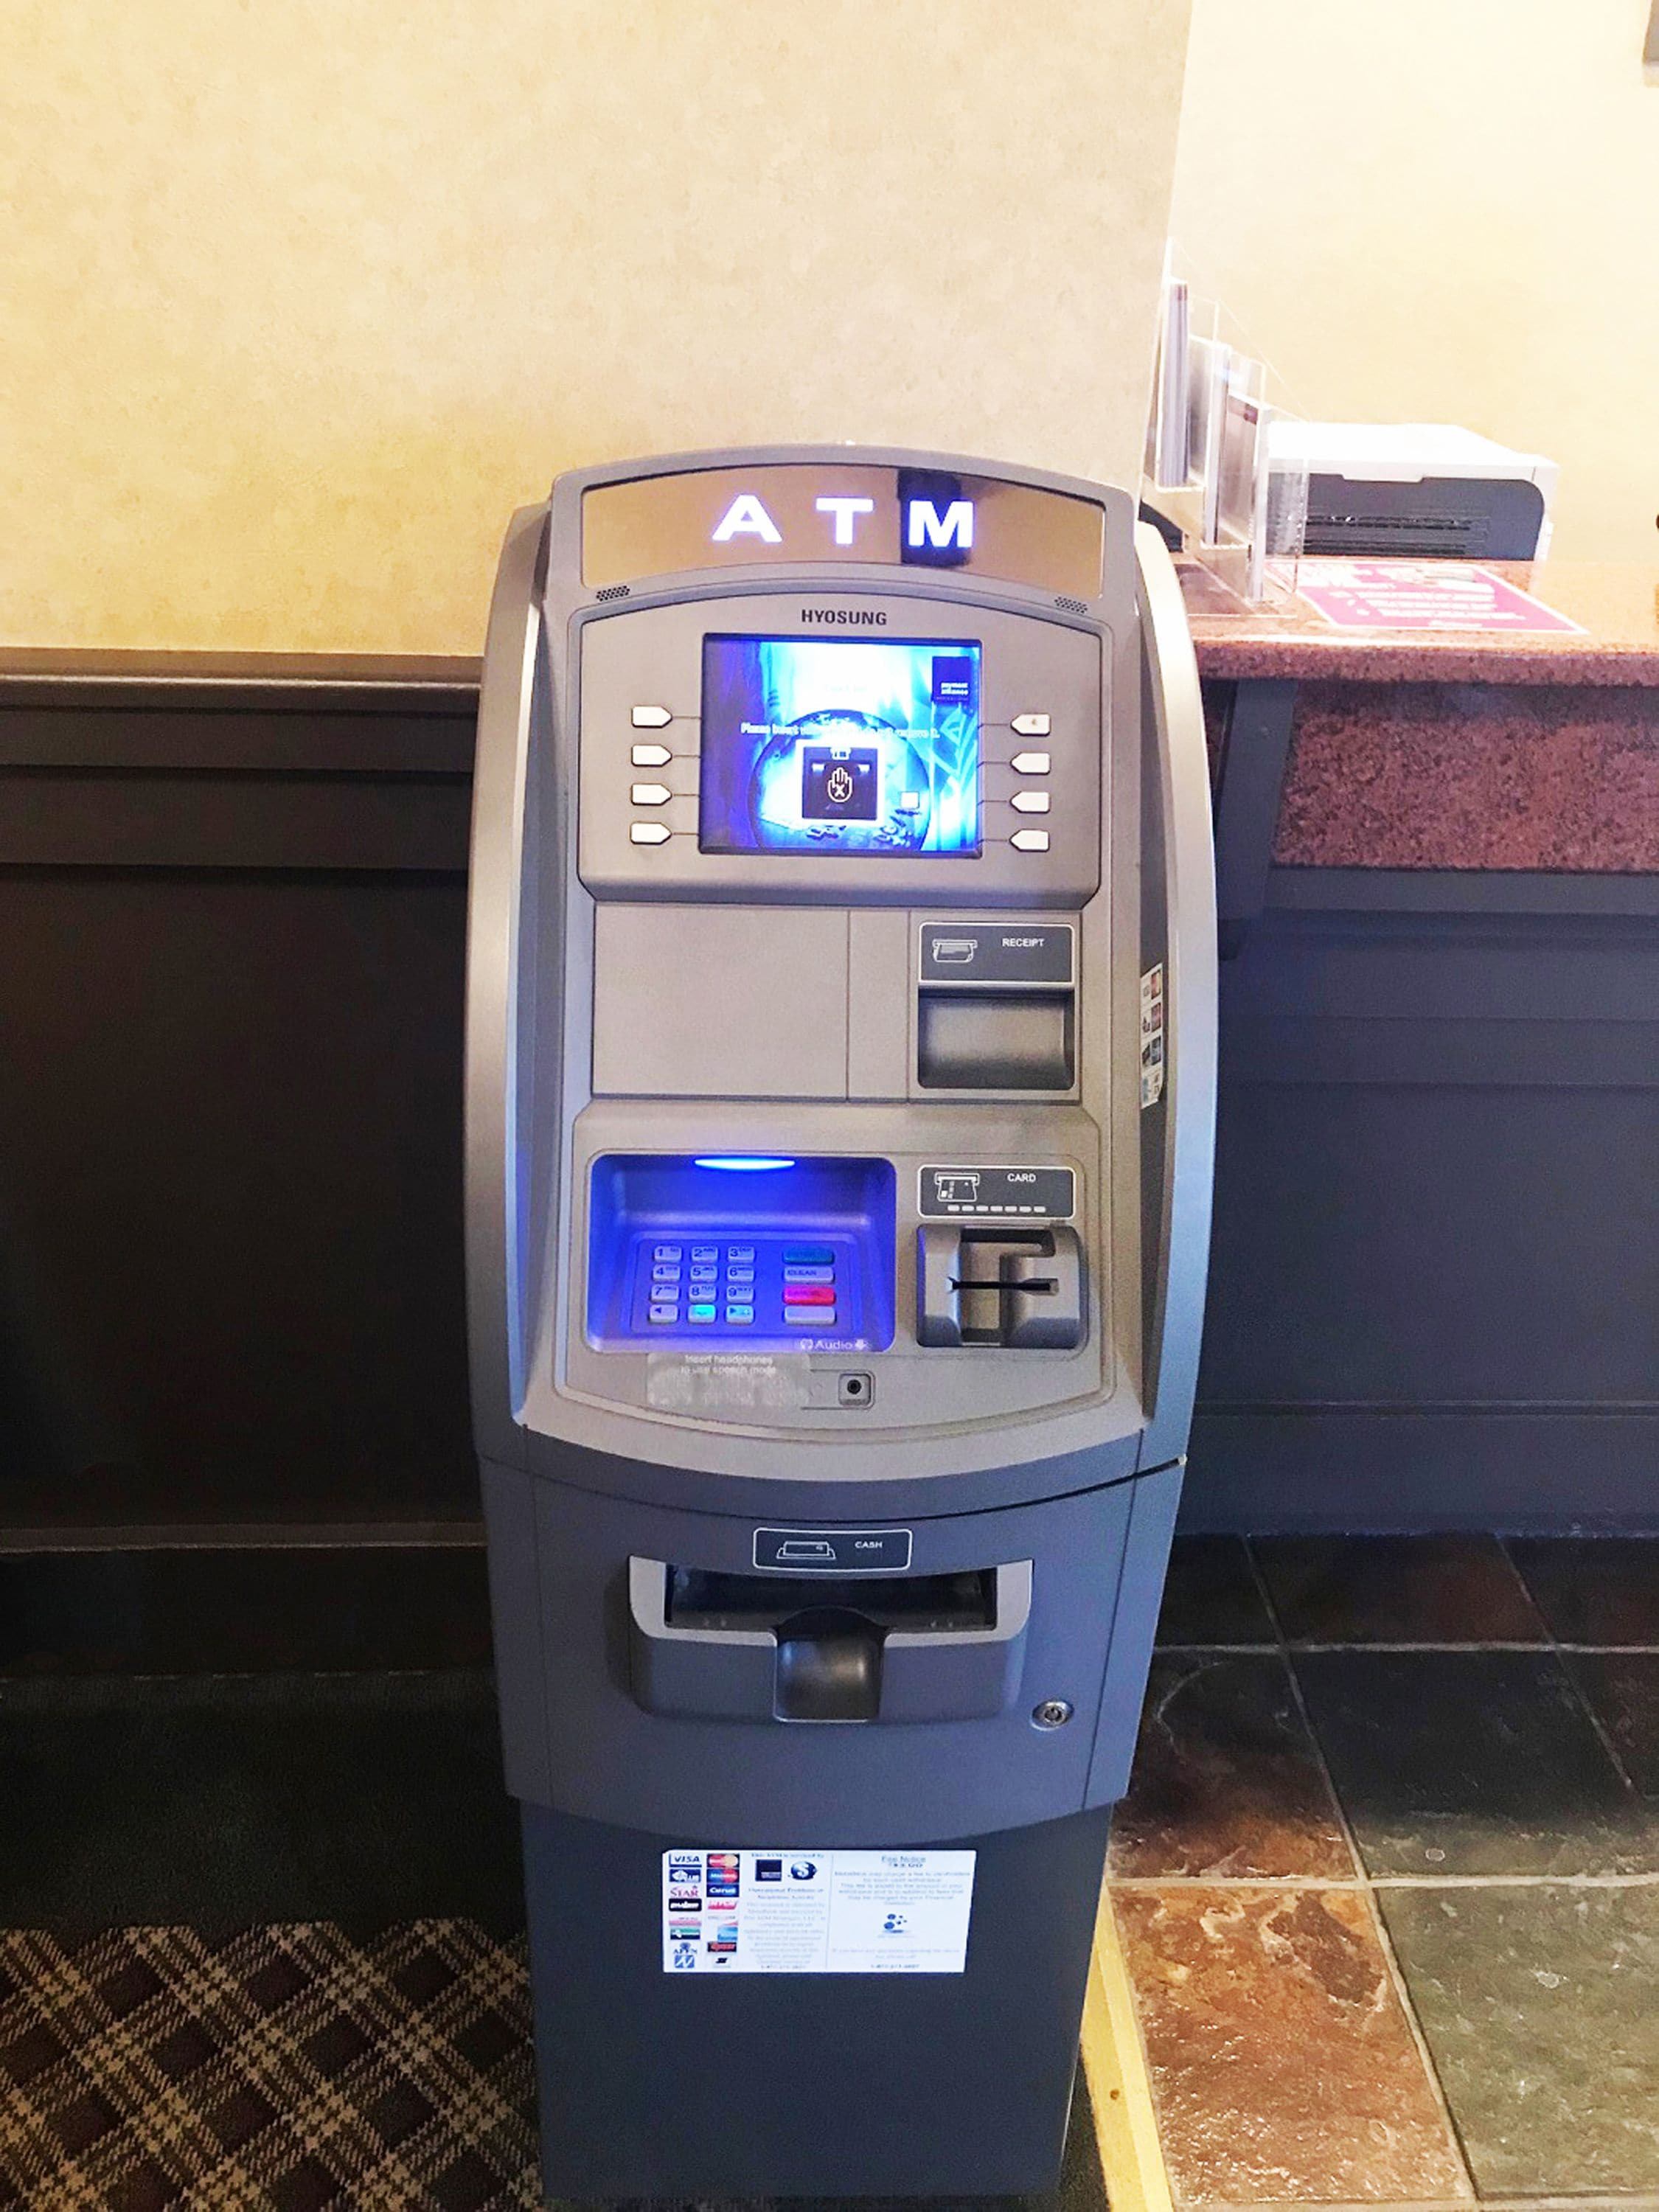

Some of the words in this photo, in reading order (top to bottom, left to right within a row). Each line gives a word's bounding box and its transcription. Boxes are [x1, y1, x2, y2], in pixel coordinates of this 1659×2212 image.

[712, 494, 974, 548] ATM
[801, 609, 888, 625] HYOSUNG
[740, 722, 771, 734] Please
[1002, 937, 1045, 947] RECEIPT
[1006, 1172, 1037, 1183] CARD
[657, 1248, 663, 1256] 1
[693, 1248, 703, 1257] 2
[729, 1248, 738, 1257] 3
[655, 1267, 664, 1276] 4
[692, 1267, 701, 1276] 5
[729, 1267, 738, 1277] 6
[654, 1287, 663, 1296] 7
[691, 1287, 700, 1296] 8
[728, 1287, 737, 1297] 9
[815, 1340, 853, 1350] Audio
[684, 1354, 712, 1364] Insert
[713, 1354, 773, 1366] headphones
[750, 1366, 776, 1374] mode
[670, 1888, 698, 1896] STAR
